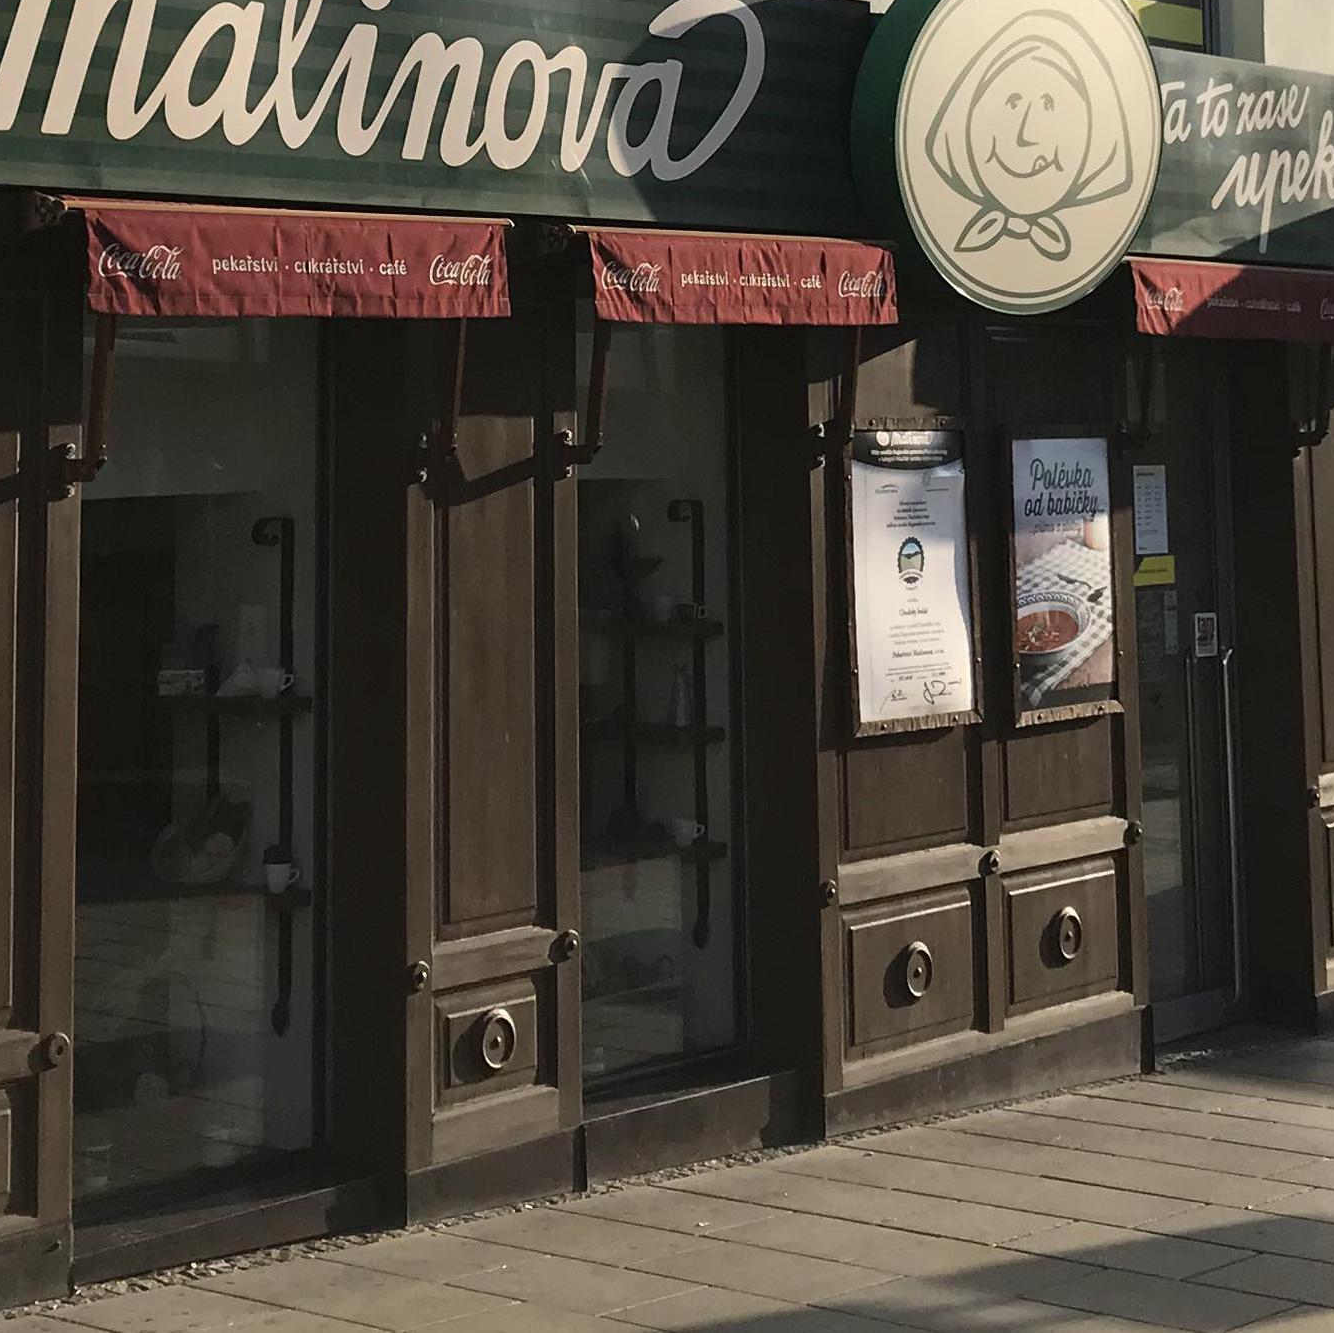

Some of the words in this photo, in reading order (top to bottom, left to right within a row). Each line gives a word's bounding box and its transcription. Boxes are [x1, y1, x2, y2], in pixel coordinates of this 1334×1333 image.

[1196, 77, 1233, 138] to
[1235, 84, 1311, 136] zase
[378, 256, 408, 276] café
[1029, 458, 1095, 491] Polévka
[1024, 492, 1045, 517] od
